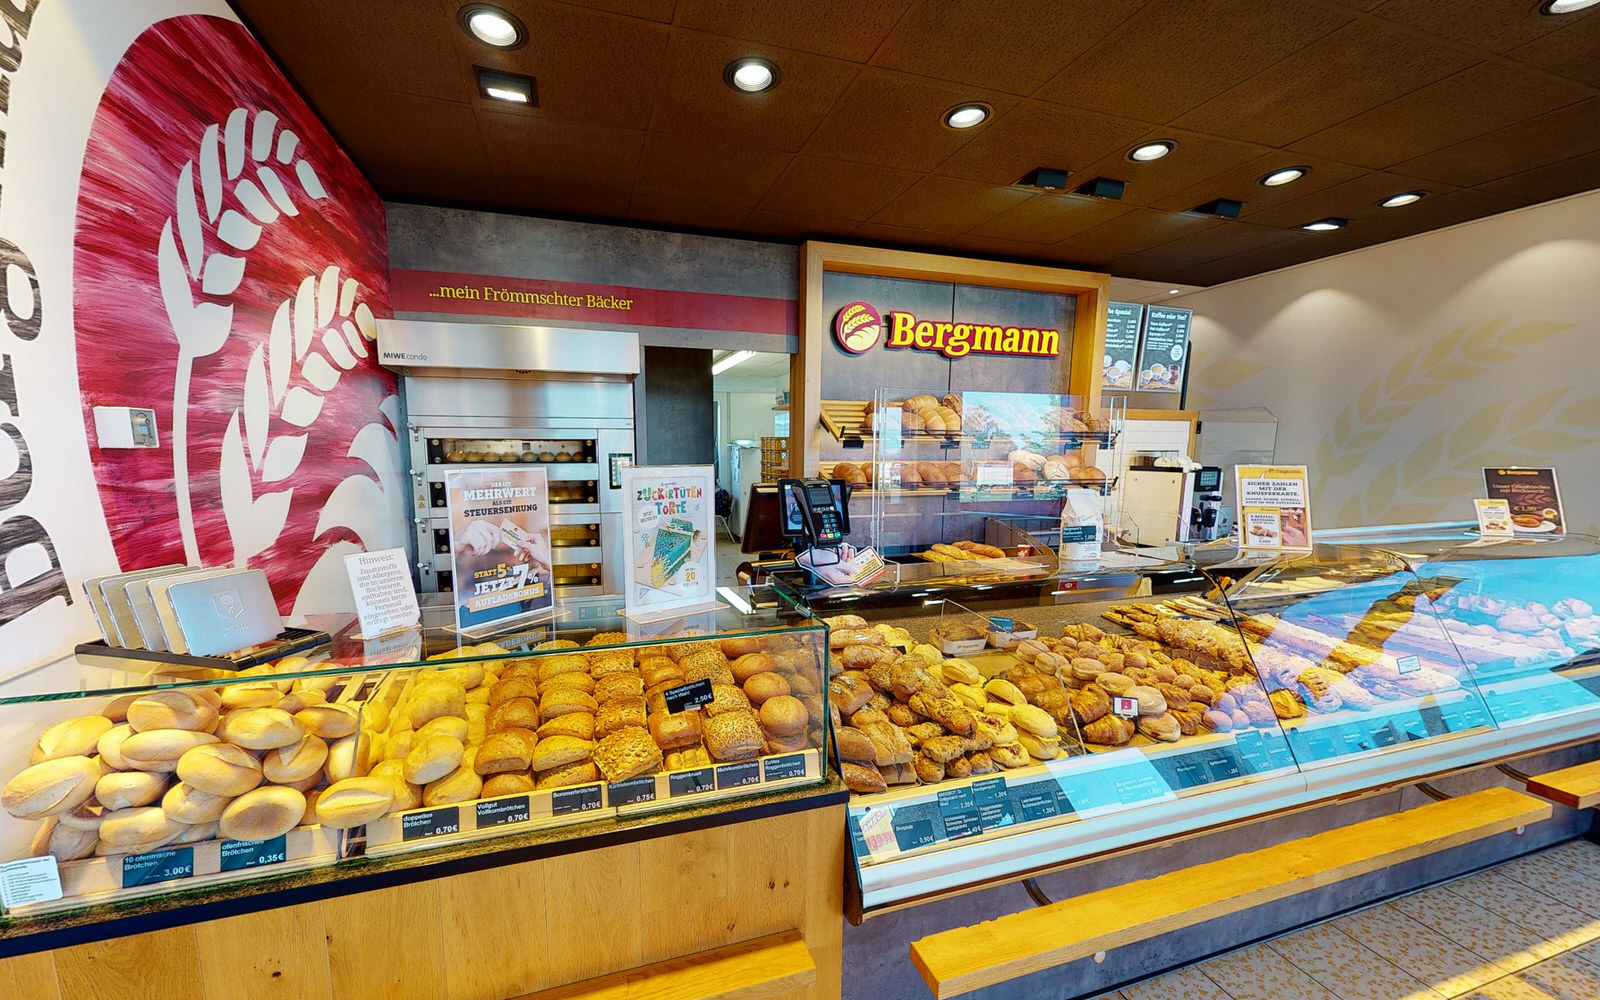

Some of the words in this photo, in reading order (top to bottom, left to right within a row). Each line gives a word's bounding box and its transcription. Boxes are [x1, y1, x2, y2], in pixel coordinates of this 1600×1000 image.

[429, 286, 480, 300] ...mein
[483, 286, 584, 307] Frömmschter
[586, 294, 634, 310] Bäcker
[889, 311, 1060, 356] Bergmann
[406, 353, 428, 361] condo
[463, 486, 537, 501] MEHRWERT
[464, 504, 538, 518] STEUERSENKUNG
[655, 500, 687, 516] TORTE
[359, 553, 395, 565] Hinweis:
[360, 564, 398, 575] Zusatzstoffe
[473, 568, 498, 579] STATT
[379, 575, 405, 584] unseren
[685, 571, 696, 582] 20
[366, 582, 402, 594] Backwaren
[474, 576, 515, 596] JETZT
[361, 590, 393, 601] enthalten
[475, 586, 541, 608] AUFLADEBONUS
[365, 597, 391, 607] können
[374, 600, 402, 611] Personal
[364, 608, 400, 620] eingesehen
[400, 604, 414, 612] oder
[366, 616, 390, 626] erfragt
[390, 610, 416, 620] werden.
[678, 690, 691, 698] Wahl
[717, 761, 759, 773] Mehrkornbrötchen
[553, 786, 599, 798] Sommerbrötchen
[636, 793, 655, 802] 0,75€
[477, 802, 498, 810] Vollgut
[477, 803, 526, 816] Vollkornbrötchen
[581, 801, 602, 811] 0,70€
[403, 812, 433, 822] doppeltes
[507, 812, 529, 823] 0,70€
[403, 820, 432, 828] Brötchen
[436, 824, 458, 835] 0,70€
[125, 856, 134, 864] 10
[134, 850, 176, 862] ofenfrische
[222, 846, 254, 857] Brötchen
[259, 853, 284, 864] 0,35€
[124, 860, 158, 872] Brötchen
